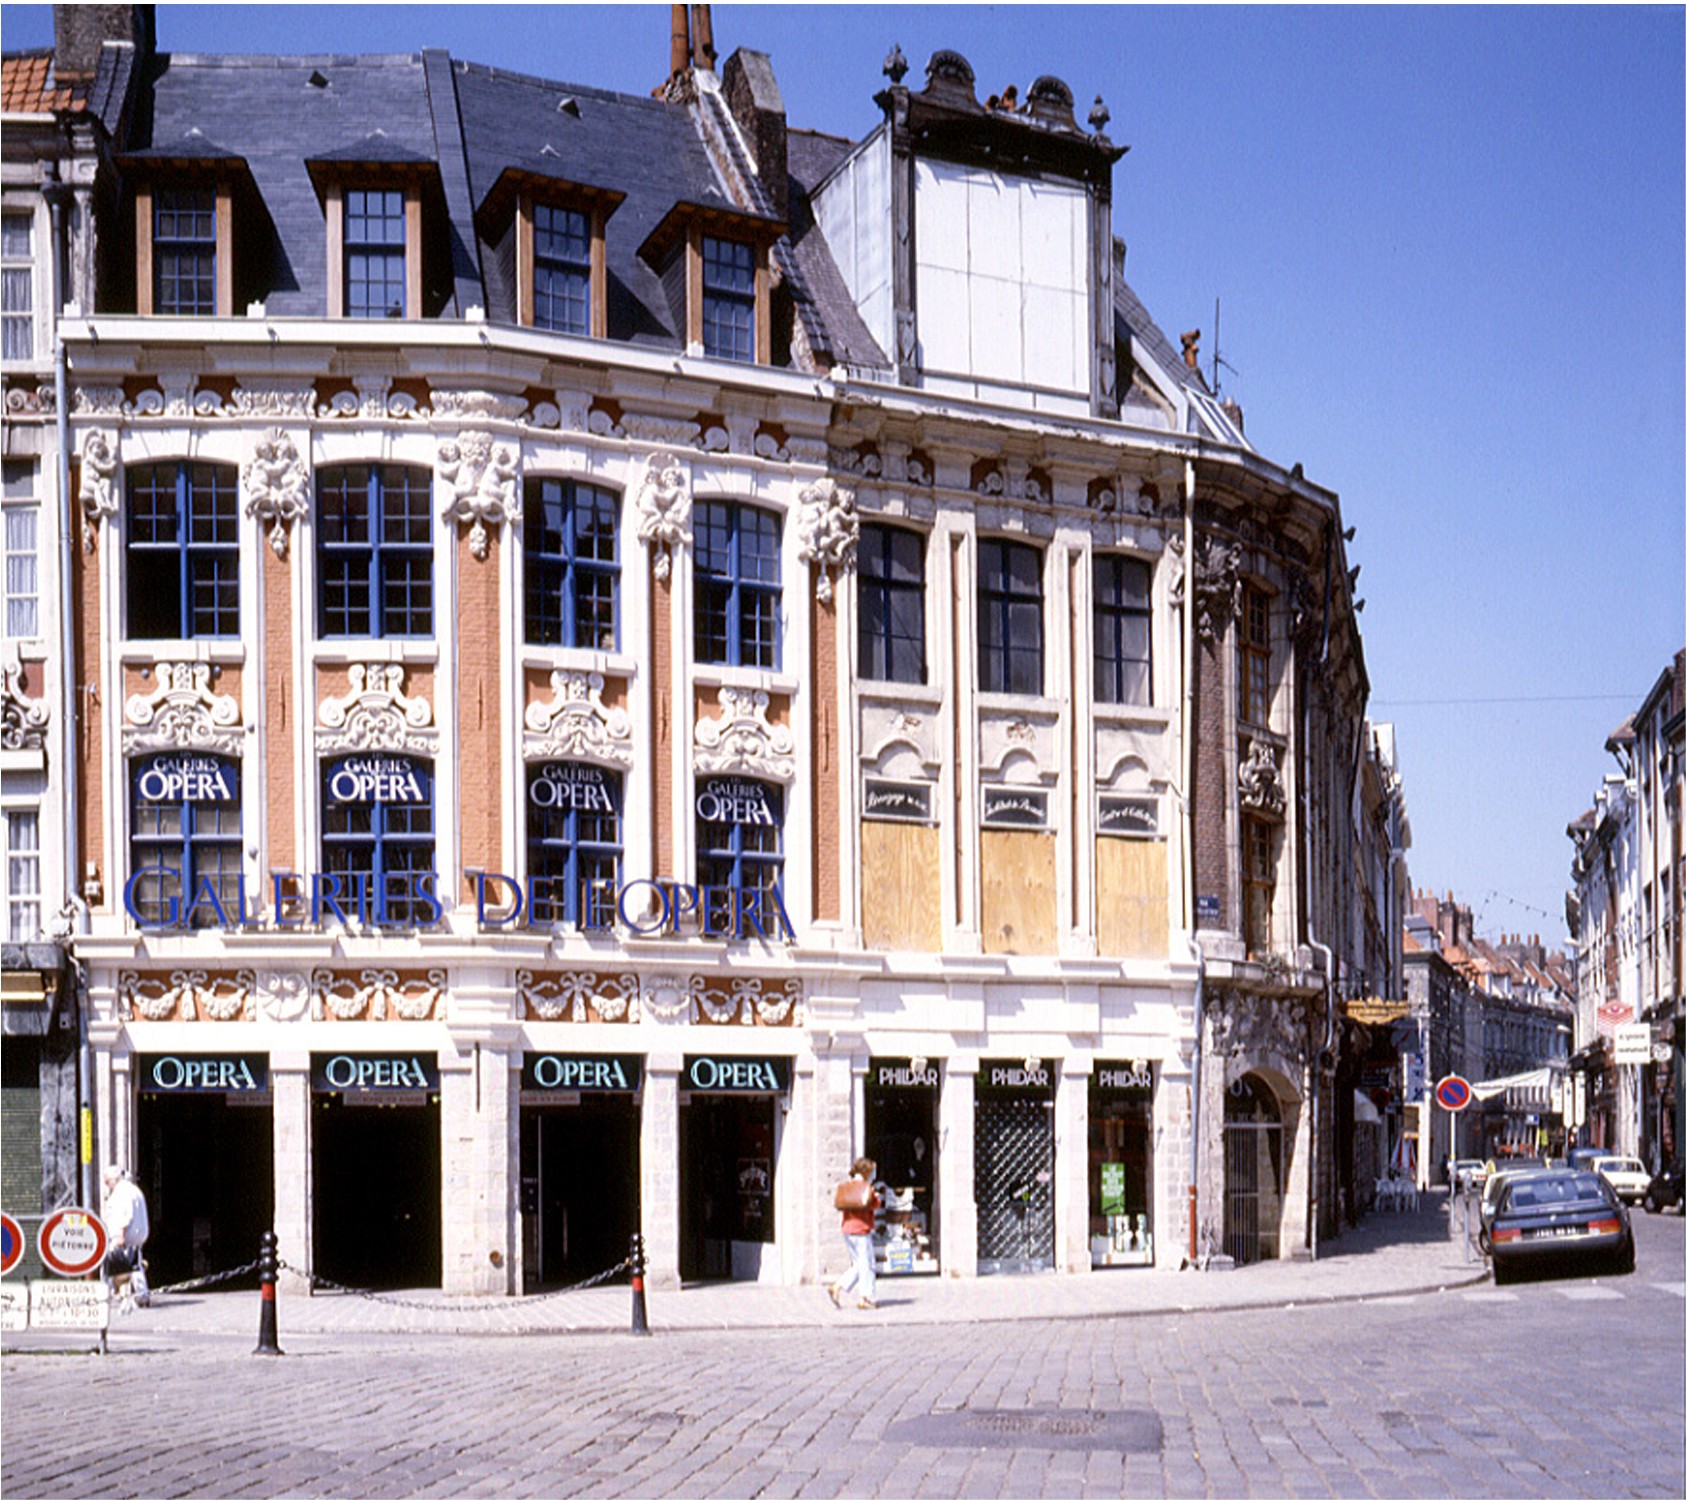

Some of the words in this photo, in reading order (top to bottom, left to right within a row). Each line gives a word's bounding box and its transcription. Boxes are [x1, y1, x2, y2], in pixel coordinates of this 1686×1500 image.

[140, 768, 231, 800] OPERA
[331, 770, 423, 801] OPERA
[530, 777, 613, 811] OPERA
[697, 793, 774, 825] OPERA
[123, 864, 443, 930] GALERIES
[476, 873, 554, 926] DE
[153, 1056, 257, 1089] OPERA
[325, 1055, 429, 1088] OPERA
[534, 1055, 628, 1088] OPERA
[690, 1057, 779, 1089] OPERA
[879, 1067, 938, 1086] PHILDAR
[991, 1067, 1049, 1086] PHILDAR
[1099, 1069, 1151, 1087] PHILDAR
